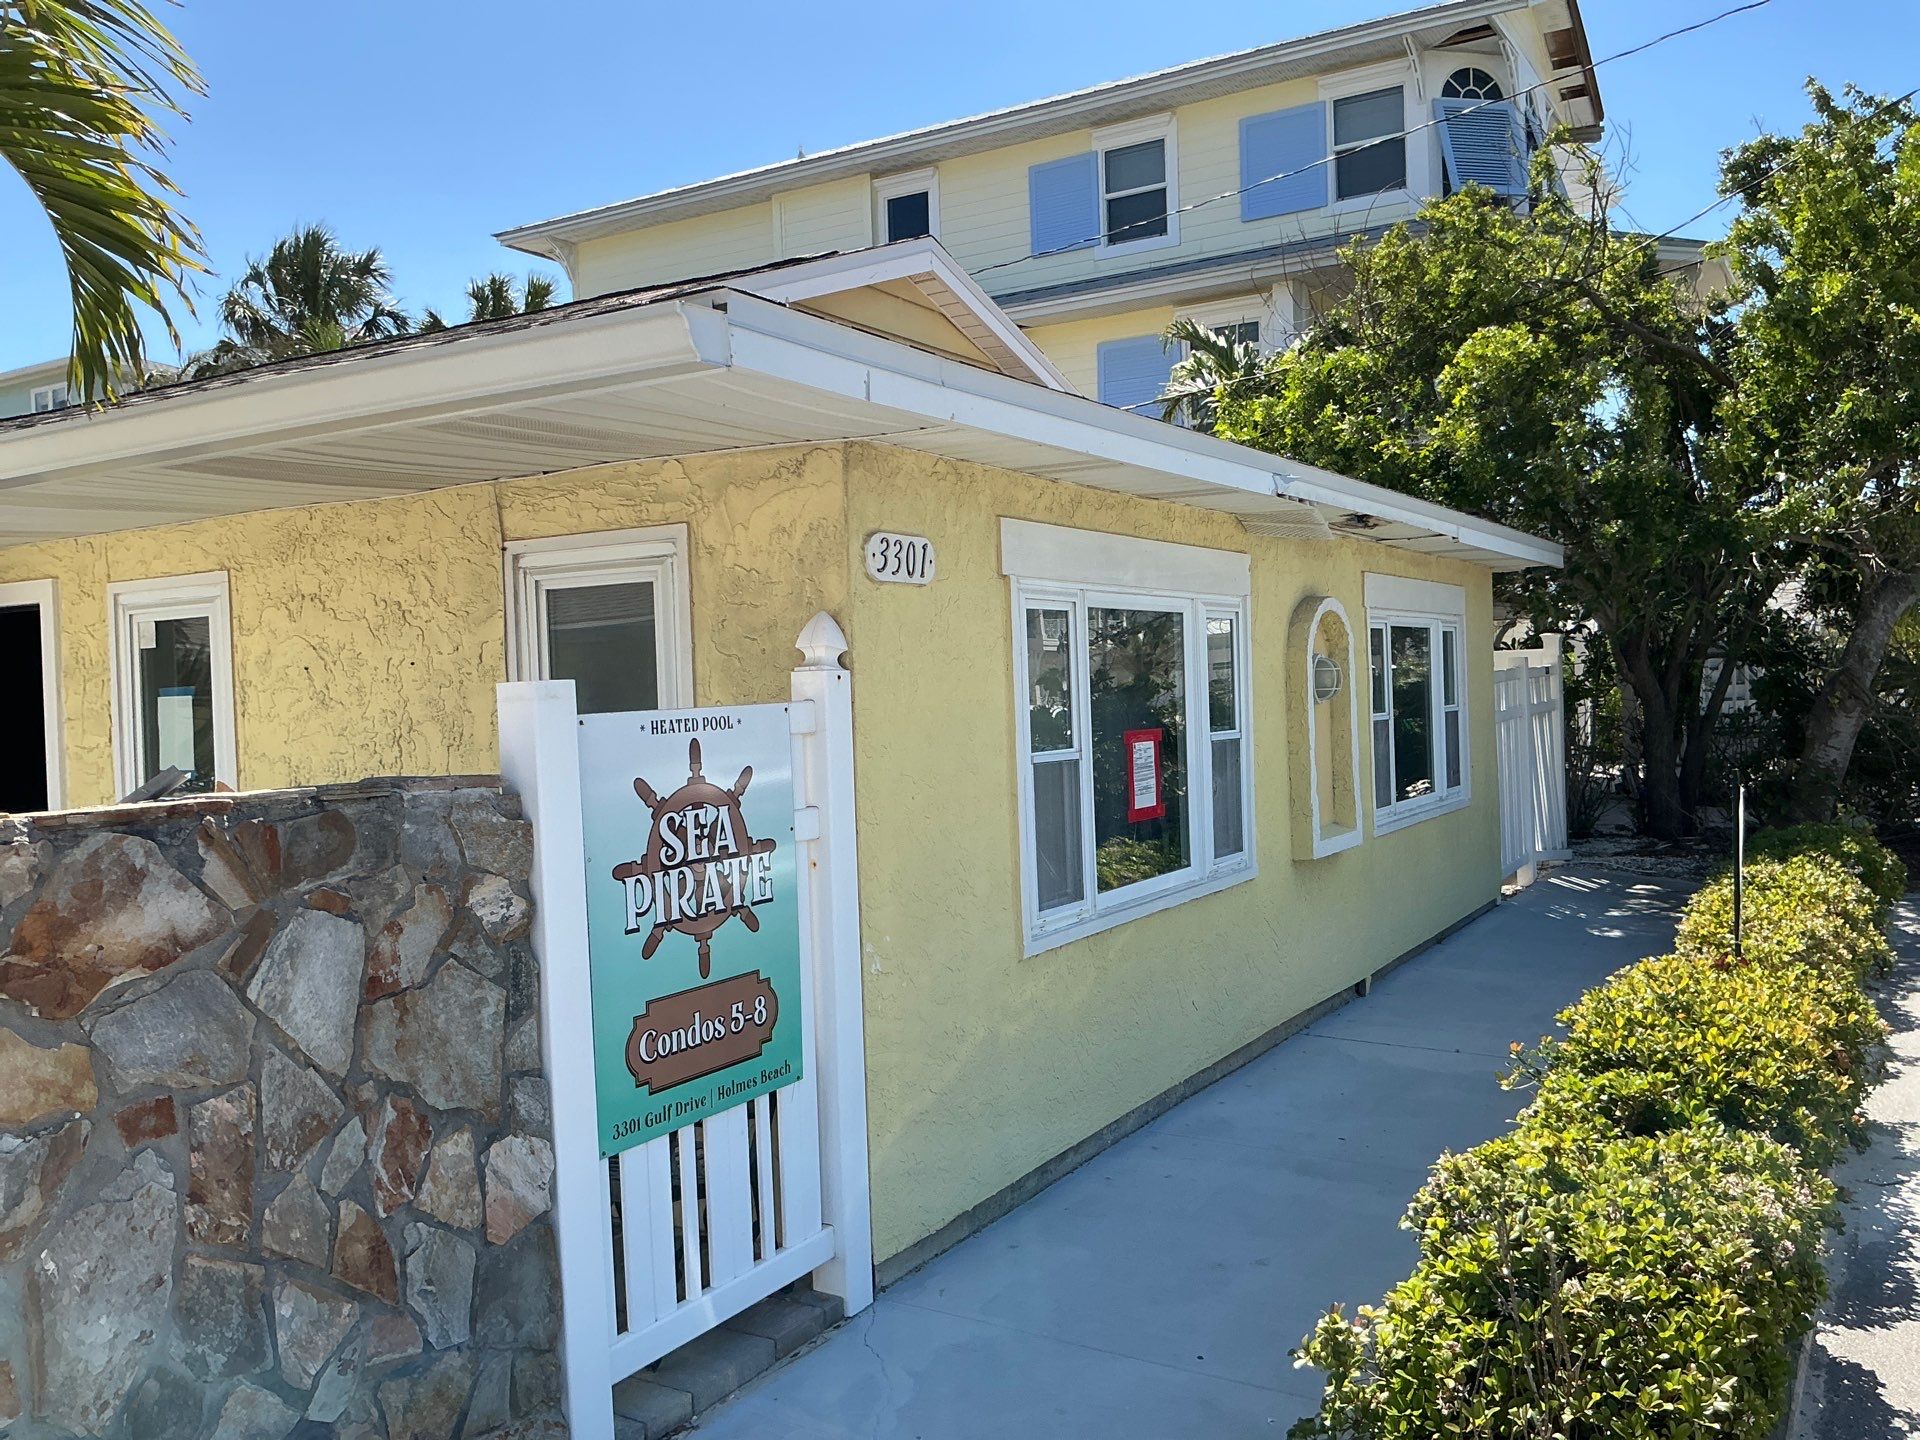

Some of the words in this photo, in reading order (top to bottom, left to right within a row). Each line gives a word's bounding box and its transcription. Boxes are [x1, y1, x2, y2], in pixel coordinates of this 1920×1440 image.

[877, 537, 928, 578] 3301
[650, 718, 699, 735] HEATED
[702, 715, 734, 731] POOL
[658, 804, 739, 867] SEA
[622, 850, 774, 934] PIRATE
[638, 1011, 726, 1063] Condos
[730, 995, 768, 1034] 5-8
[612, 1117, 641, 1140] 3301
[644, 1102, 673, 1128] Gulf
[675, 1093, 707, 1118] Drive
[717, 1076, 758, 1100] Holmes
[760, 1059, 791, 1085] Beach
